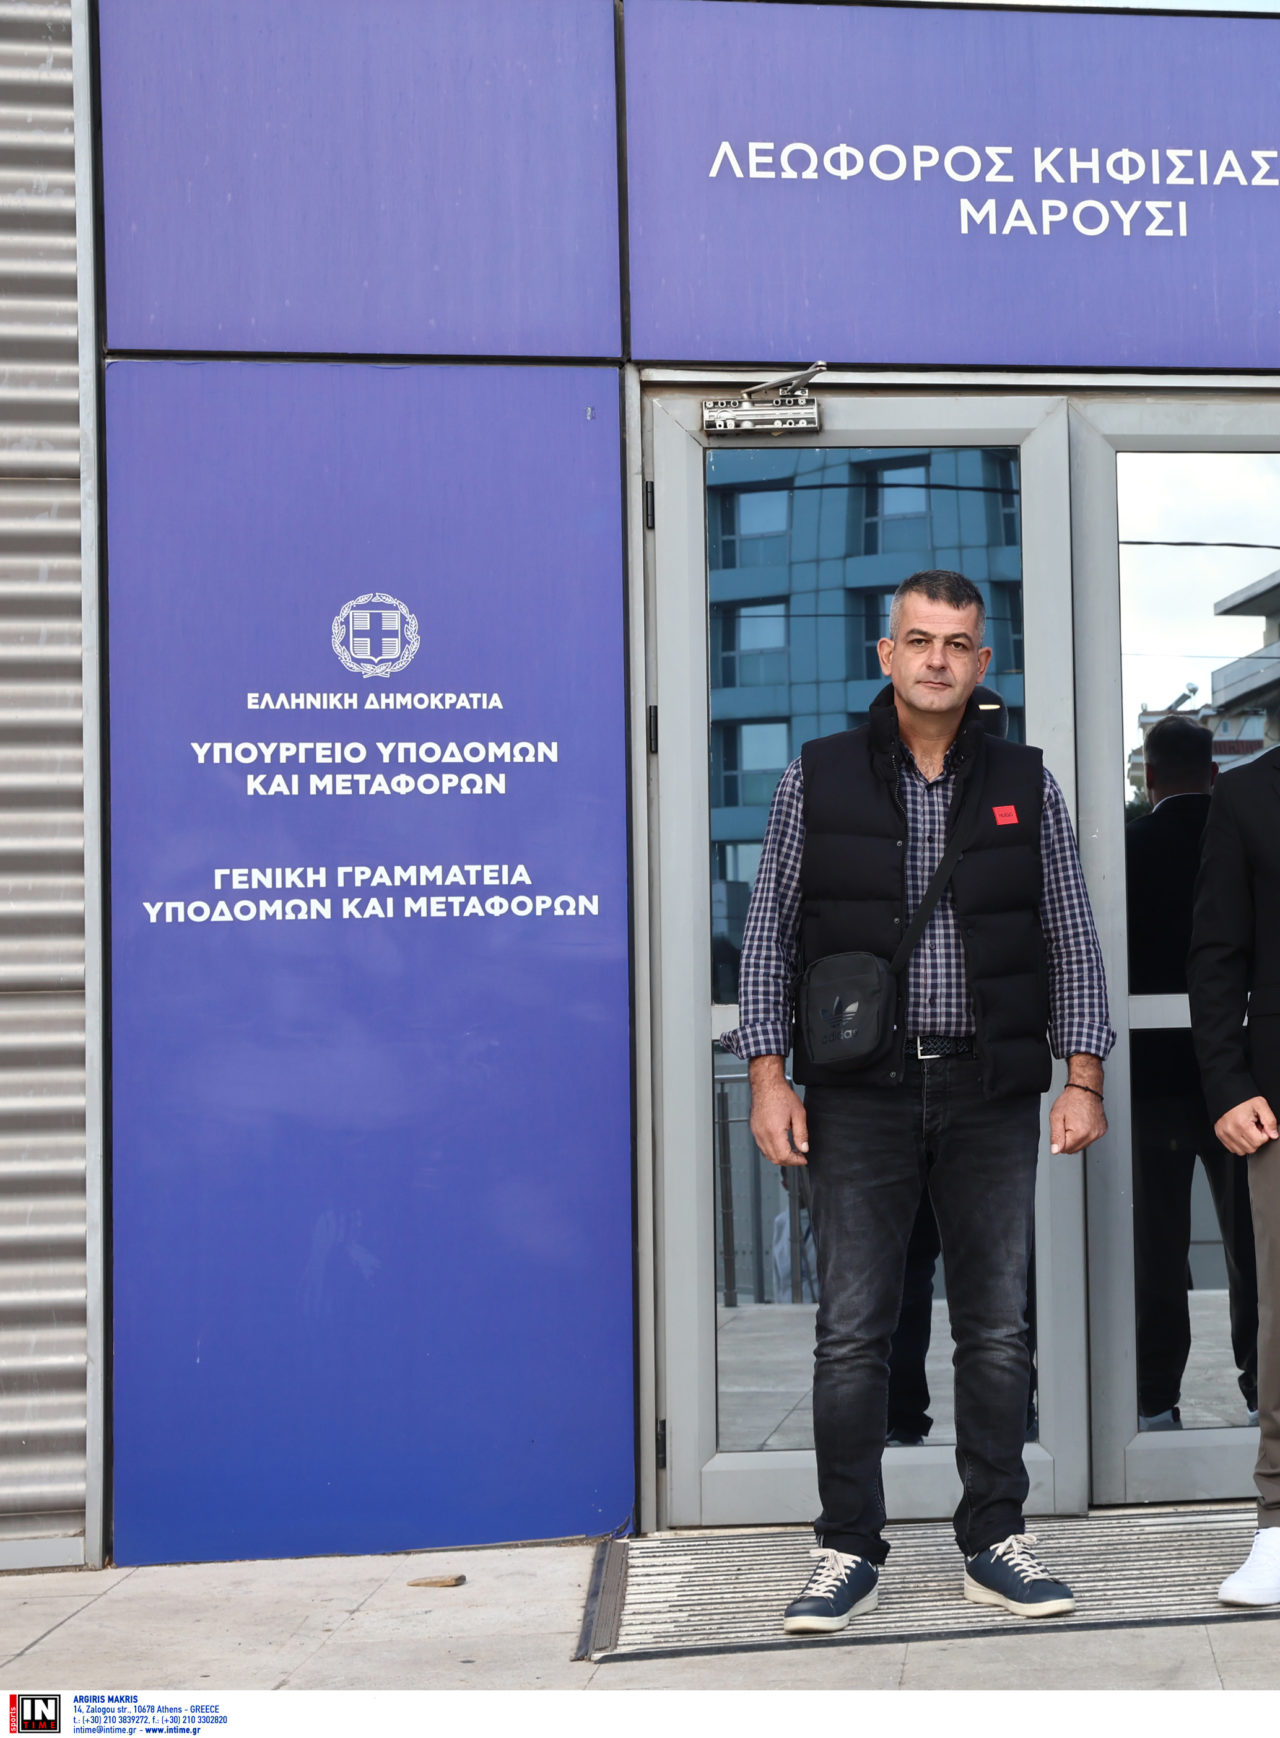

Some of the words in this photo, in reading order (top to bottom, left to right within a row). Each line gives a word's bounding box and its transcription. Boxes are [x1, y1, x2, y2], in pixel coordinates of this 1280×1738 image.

[709, 141, 1013, 182] ΛΕΩΦΟΡΟΣ
[1034, 147, 1279, 186] ΚΗΦΙΣΙΑΣ
[960, 198, 1188, 237] ΜΑΡΟΥΣΙ
[247, 693, 358, 710] ΕΛΛΗΝΙΚΗ
[365, 692, 503, 709] ΔΗΜΟΚΡΑΤΙΑ
[191, 742, 367, 764] ΥΠΟΥΡΓΕΙΟ
[376, 742, 558, 763] ΥΠΟΔΟΜΩΝ
[247, 774, 299, 796] ΚΑΙ
[310, 773, 506, 796] ΜΕΤΑΦΟΡΩΝ
[214, 867, 327, 890] ΓΕΝΙΚΗ
[337, 865, 532, 887] ΓΡΑΜΜΑΤΕΙΑ
[143, 898, 332, 923] ΥΠΟΔΟΜΩΝ
[343, 897, 394, 919] ΚΑΙ
[404, 895, 599, 918] ΜΕΤΑΦΟΡΩΝ
